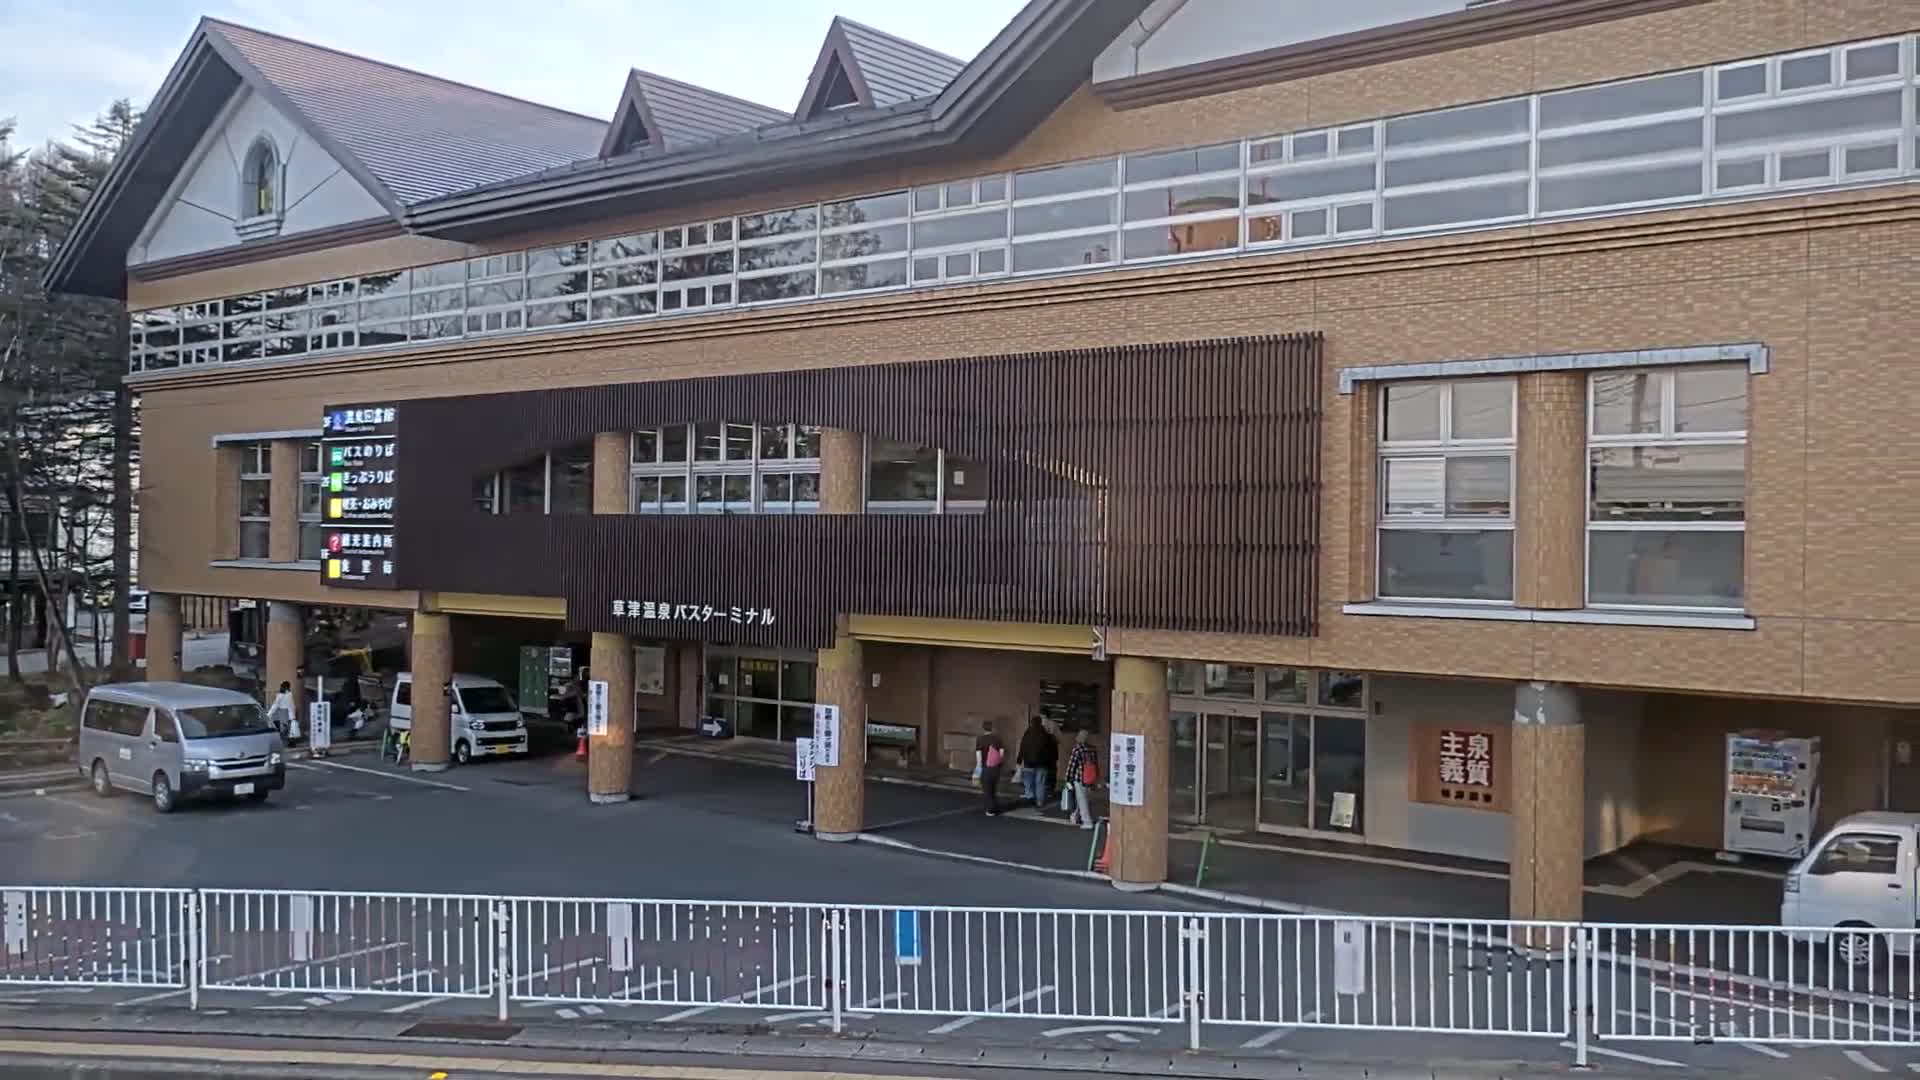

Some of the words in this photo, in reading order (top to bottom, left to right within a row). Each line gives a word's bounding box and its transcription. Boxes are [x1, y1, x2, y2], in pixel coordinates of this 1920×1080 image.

[343, 443, 395, 457] バスのりば
[343, 470, 395, 484] きっぷうりば
[611, 599, 775, 626] 草津温泉バスターミナル
